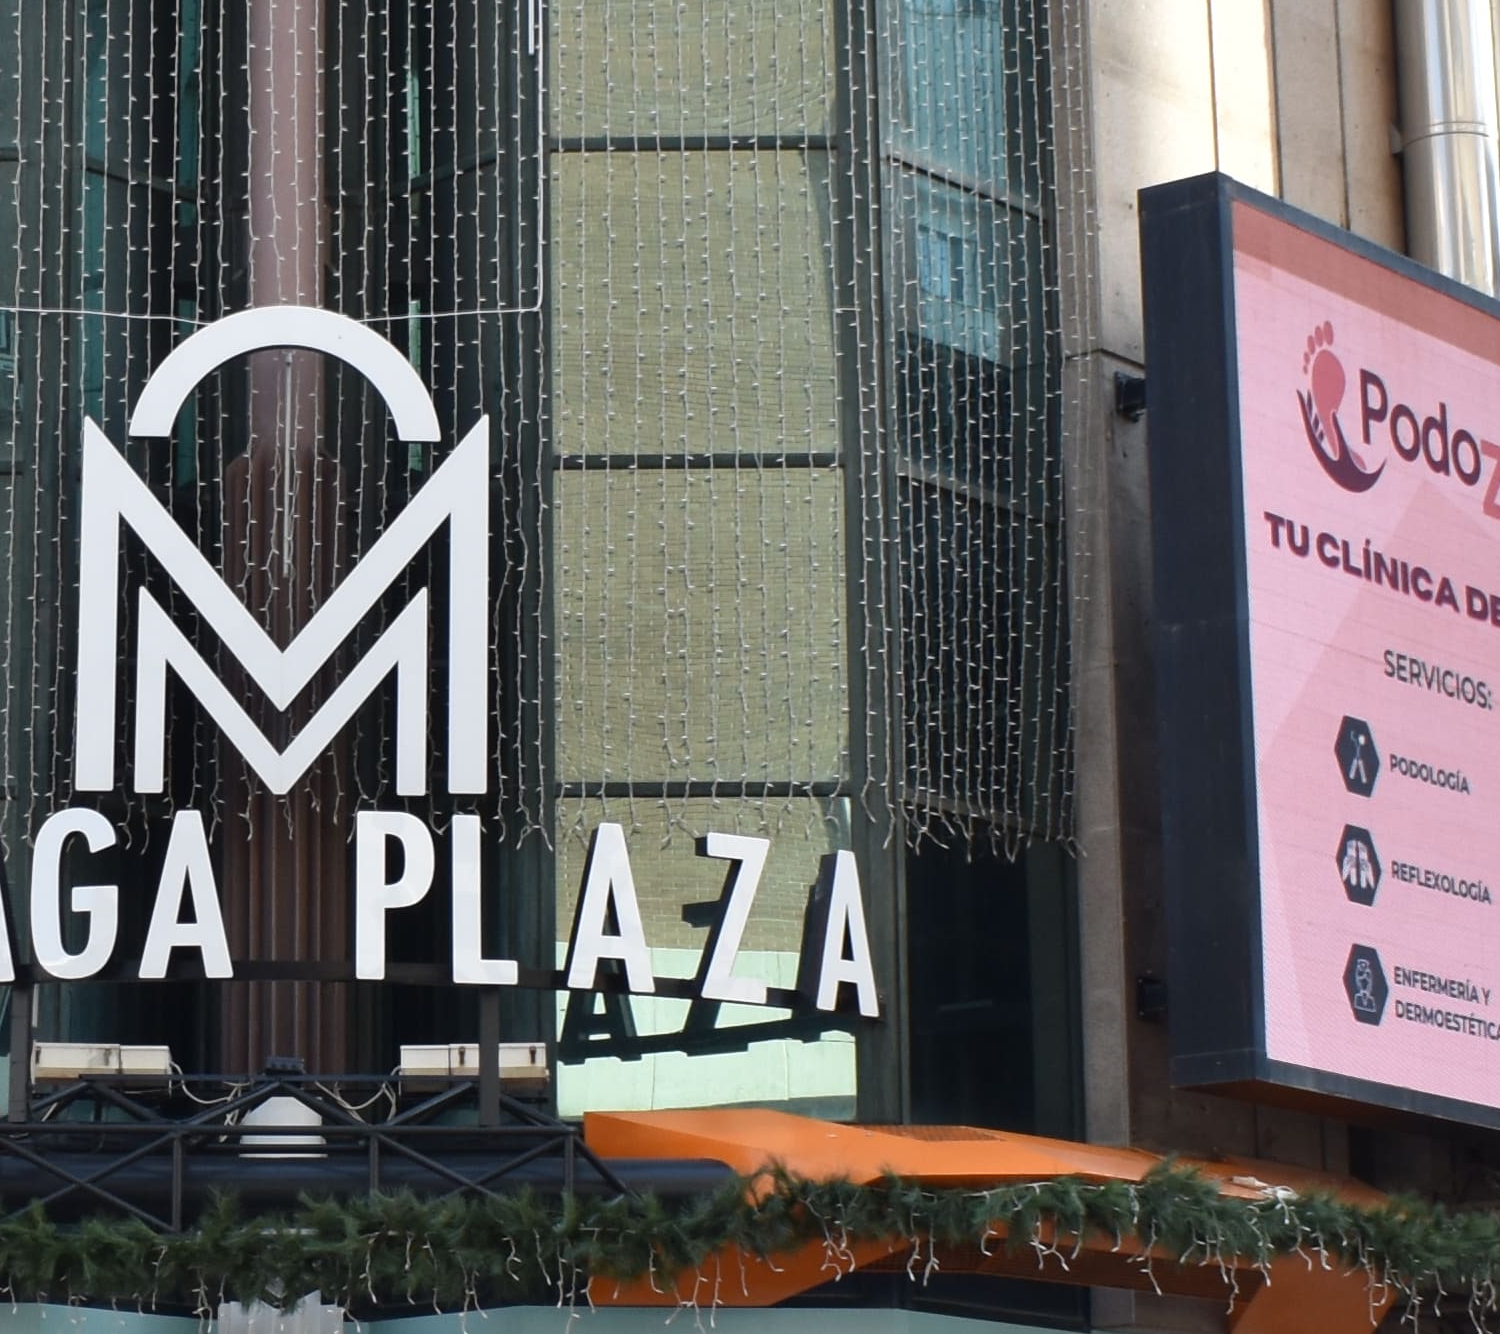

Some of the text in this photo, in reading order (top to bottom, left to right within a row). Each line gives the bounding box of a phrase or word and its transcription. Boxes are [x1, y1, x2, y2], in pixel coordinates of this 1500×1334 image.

[1264, 510, 1311, 559] TU
[1315, 537, 1462, 615] CLÍNICA
[1383, 649, 1493, 711] SERVICIOS:
[1389, 753, 1470, 795] PODOLOGÍA
[1390, 860, 1492, 905] REFLEXOLOGÍA
[355, 810, 881, 1018] PLAZA
[1393, 966, 1490, 1006] ENFERMERÍA Y
